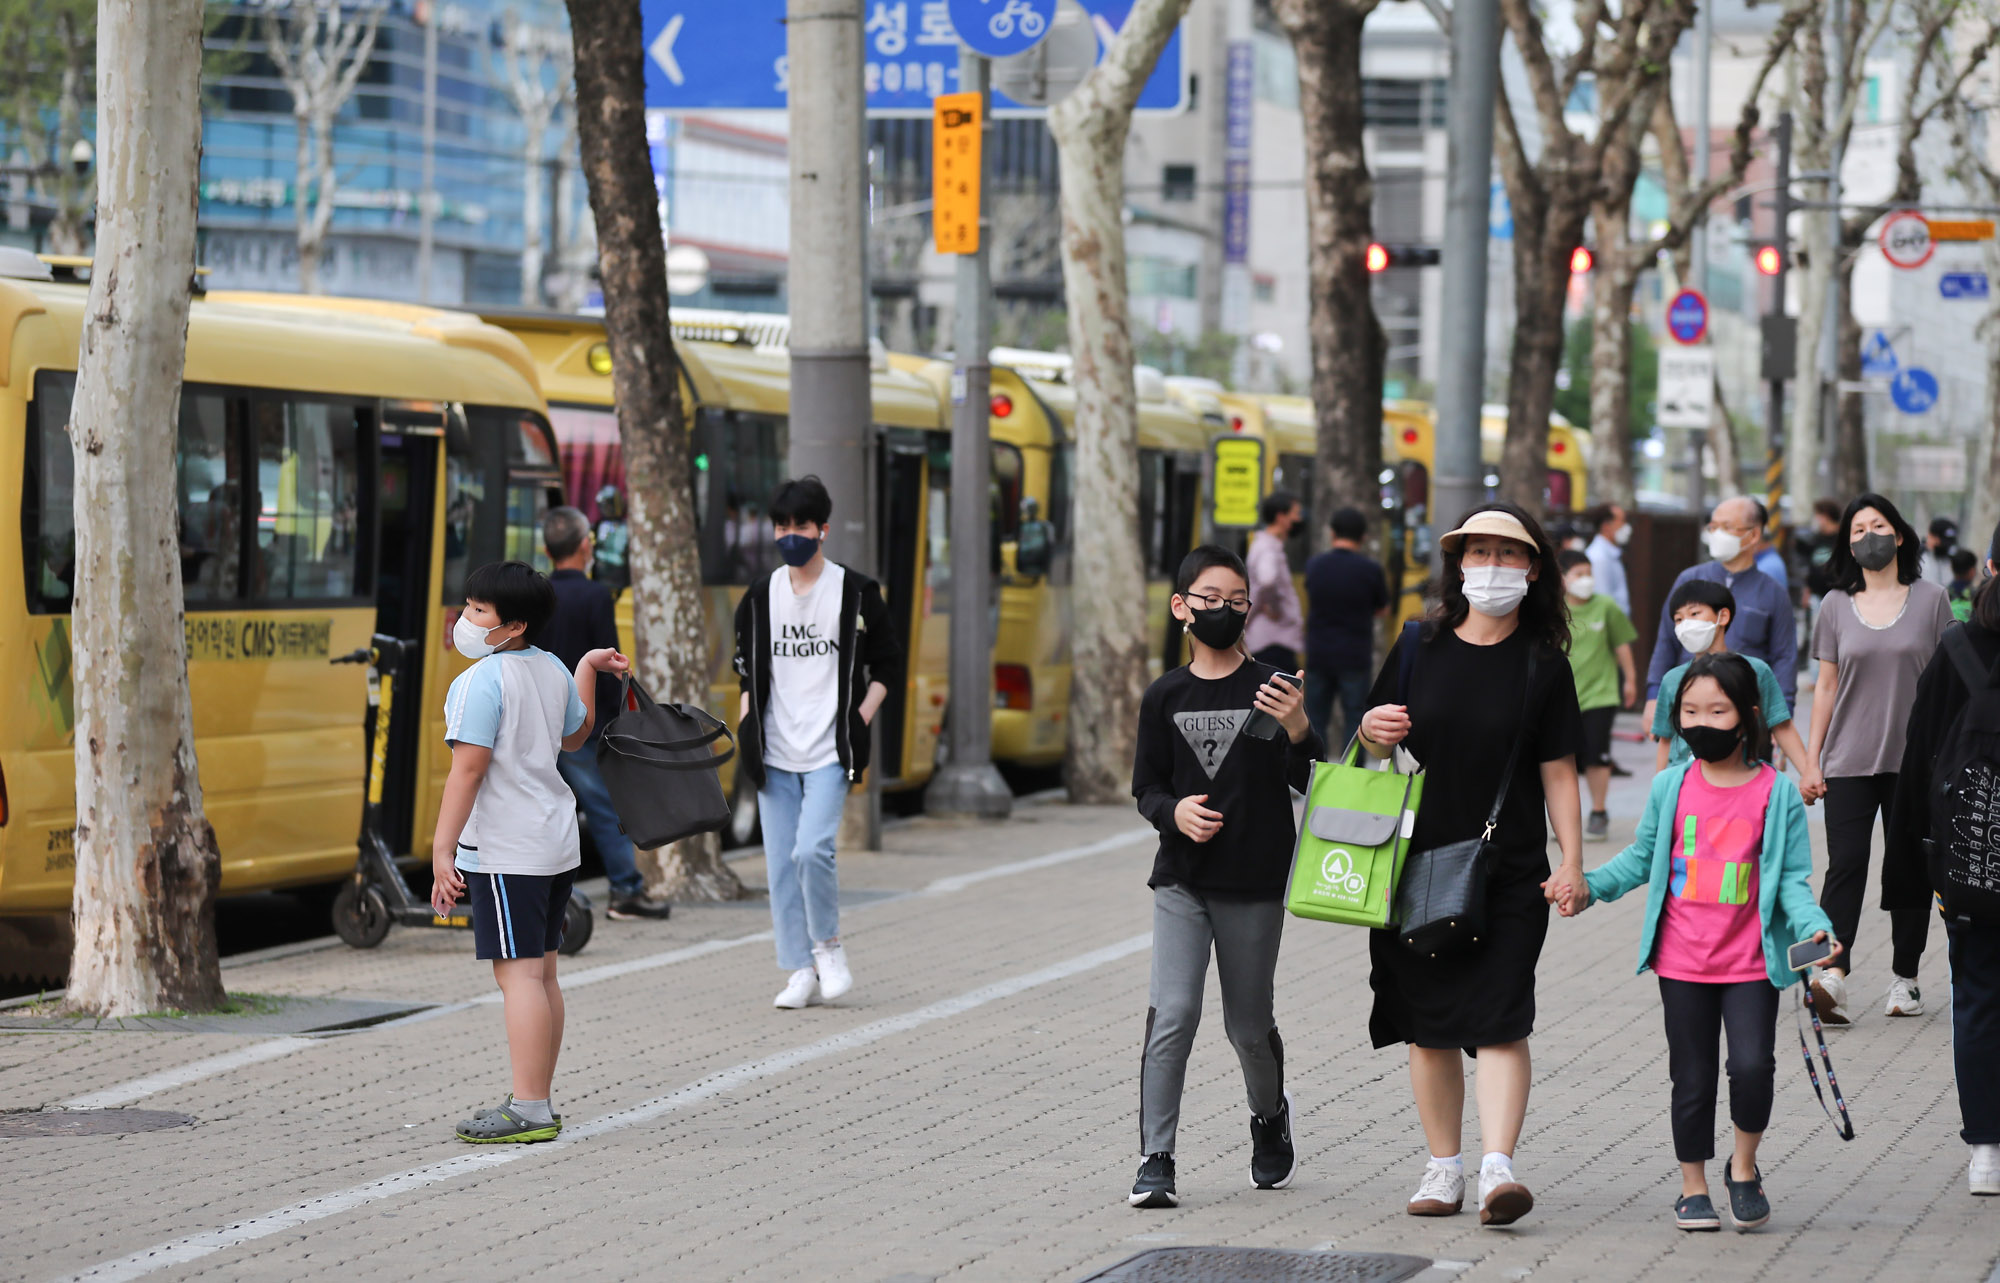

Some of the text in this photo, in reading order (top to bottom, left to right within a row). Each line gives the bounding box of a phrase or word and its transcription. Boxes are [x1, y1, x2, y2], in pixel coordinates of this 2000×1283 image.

[242, 621, 276, 657] CMS
[1183, 716, 1235, 732] GUESS
[1683, 815, 1697, 856] I
